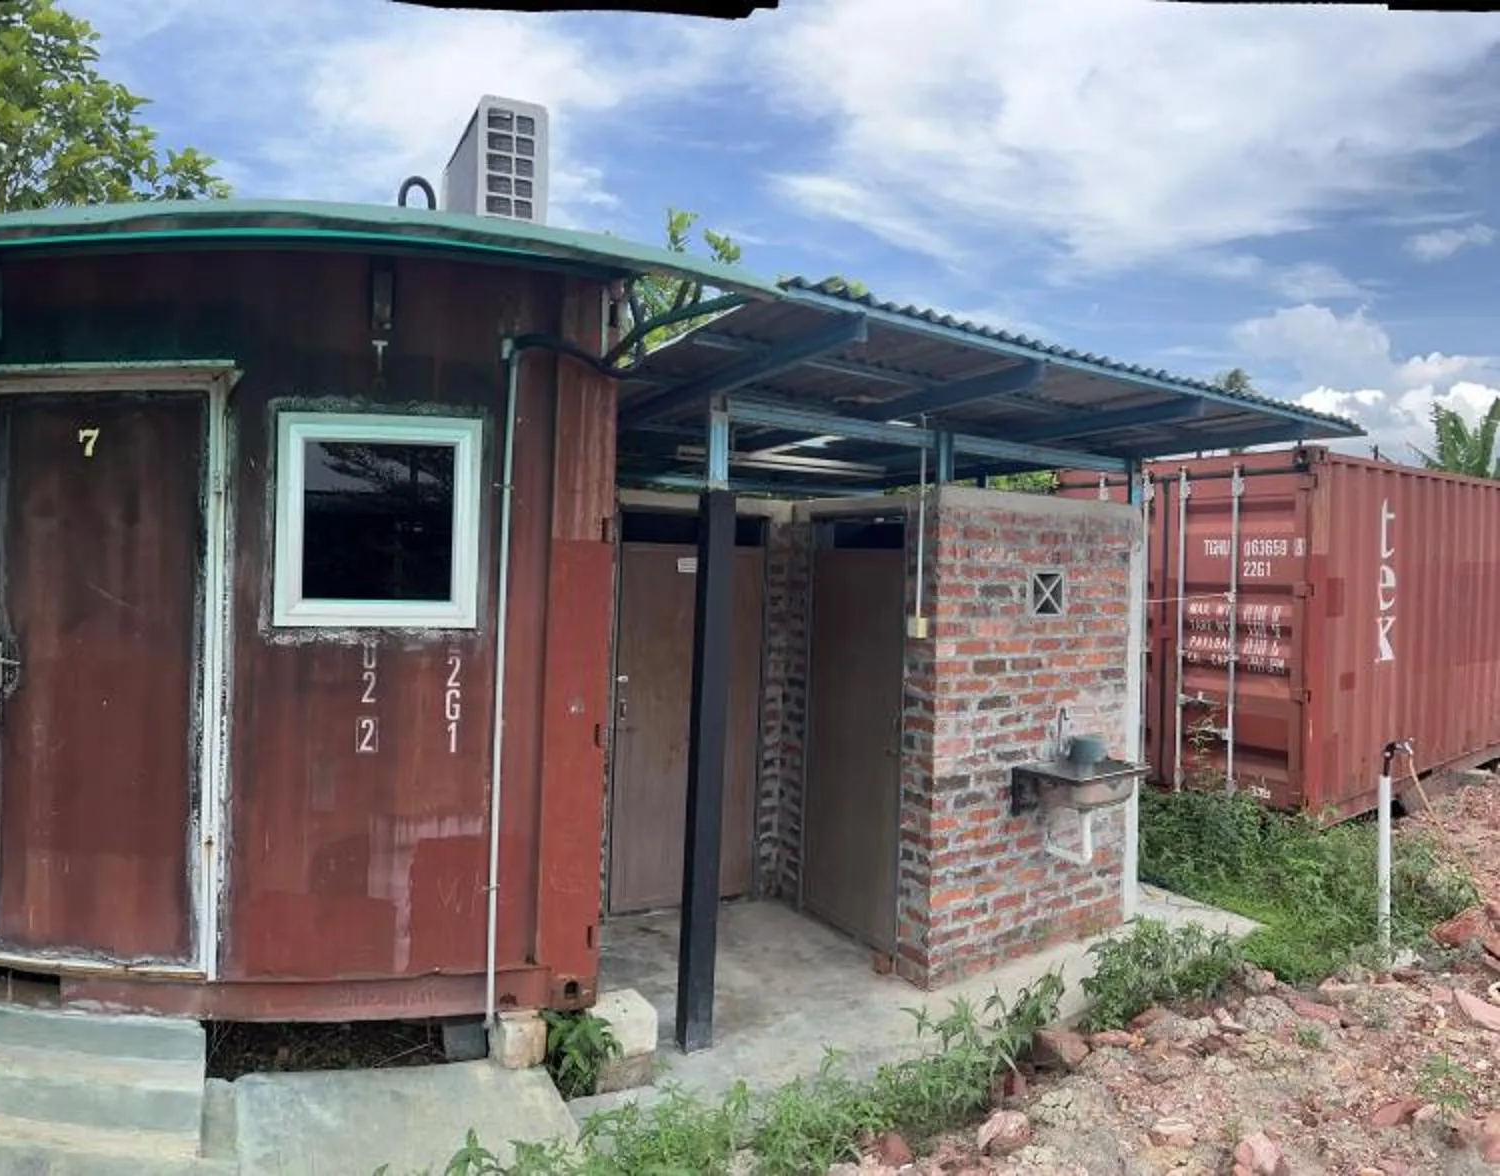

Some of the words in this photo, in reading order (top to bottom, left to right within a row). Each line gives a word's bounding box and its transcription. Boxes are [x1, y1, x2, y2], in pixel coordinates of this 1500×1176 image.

[79, 427, 100, 456] 7
[1243, 561, 1271, 577] 22G1
[445, 648, 461, 753] 2G1
[360, 719, 374, 751] 2
